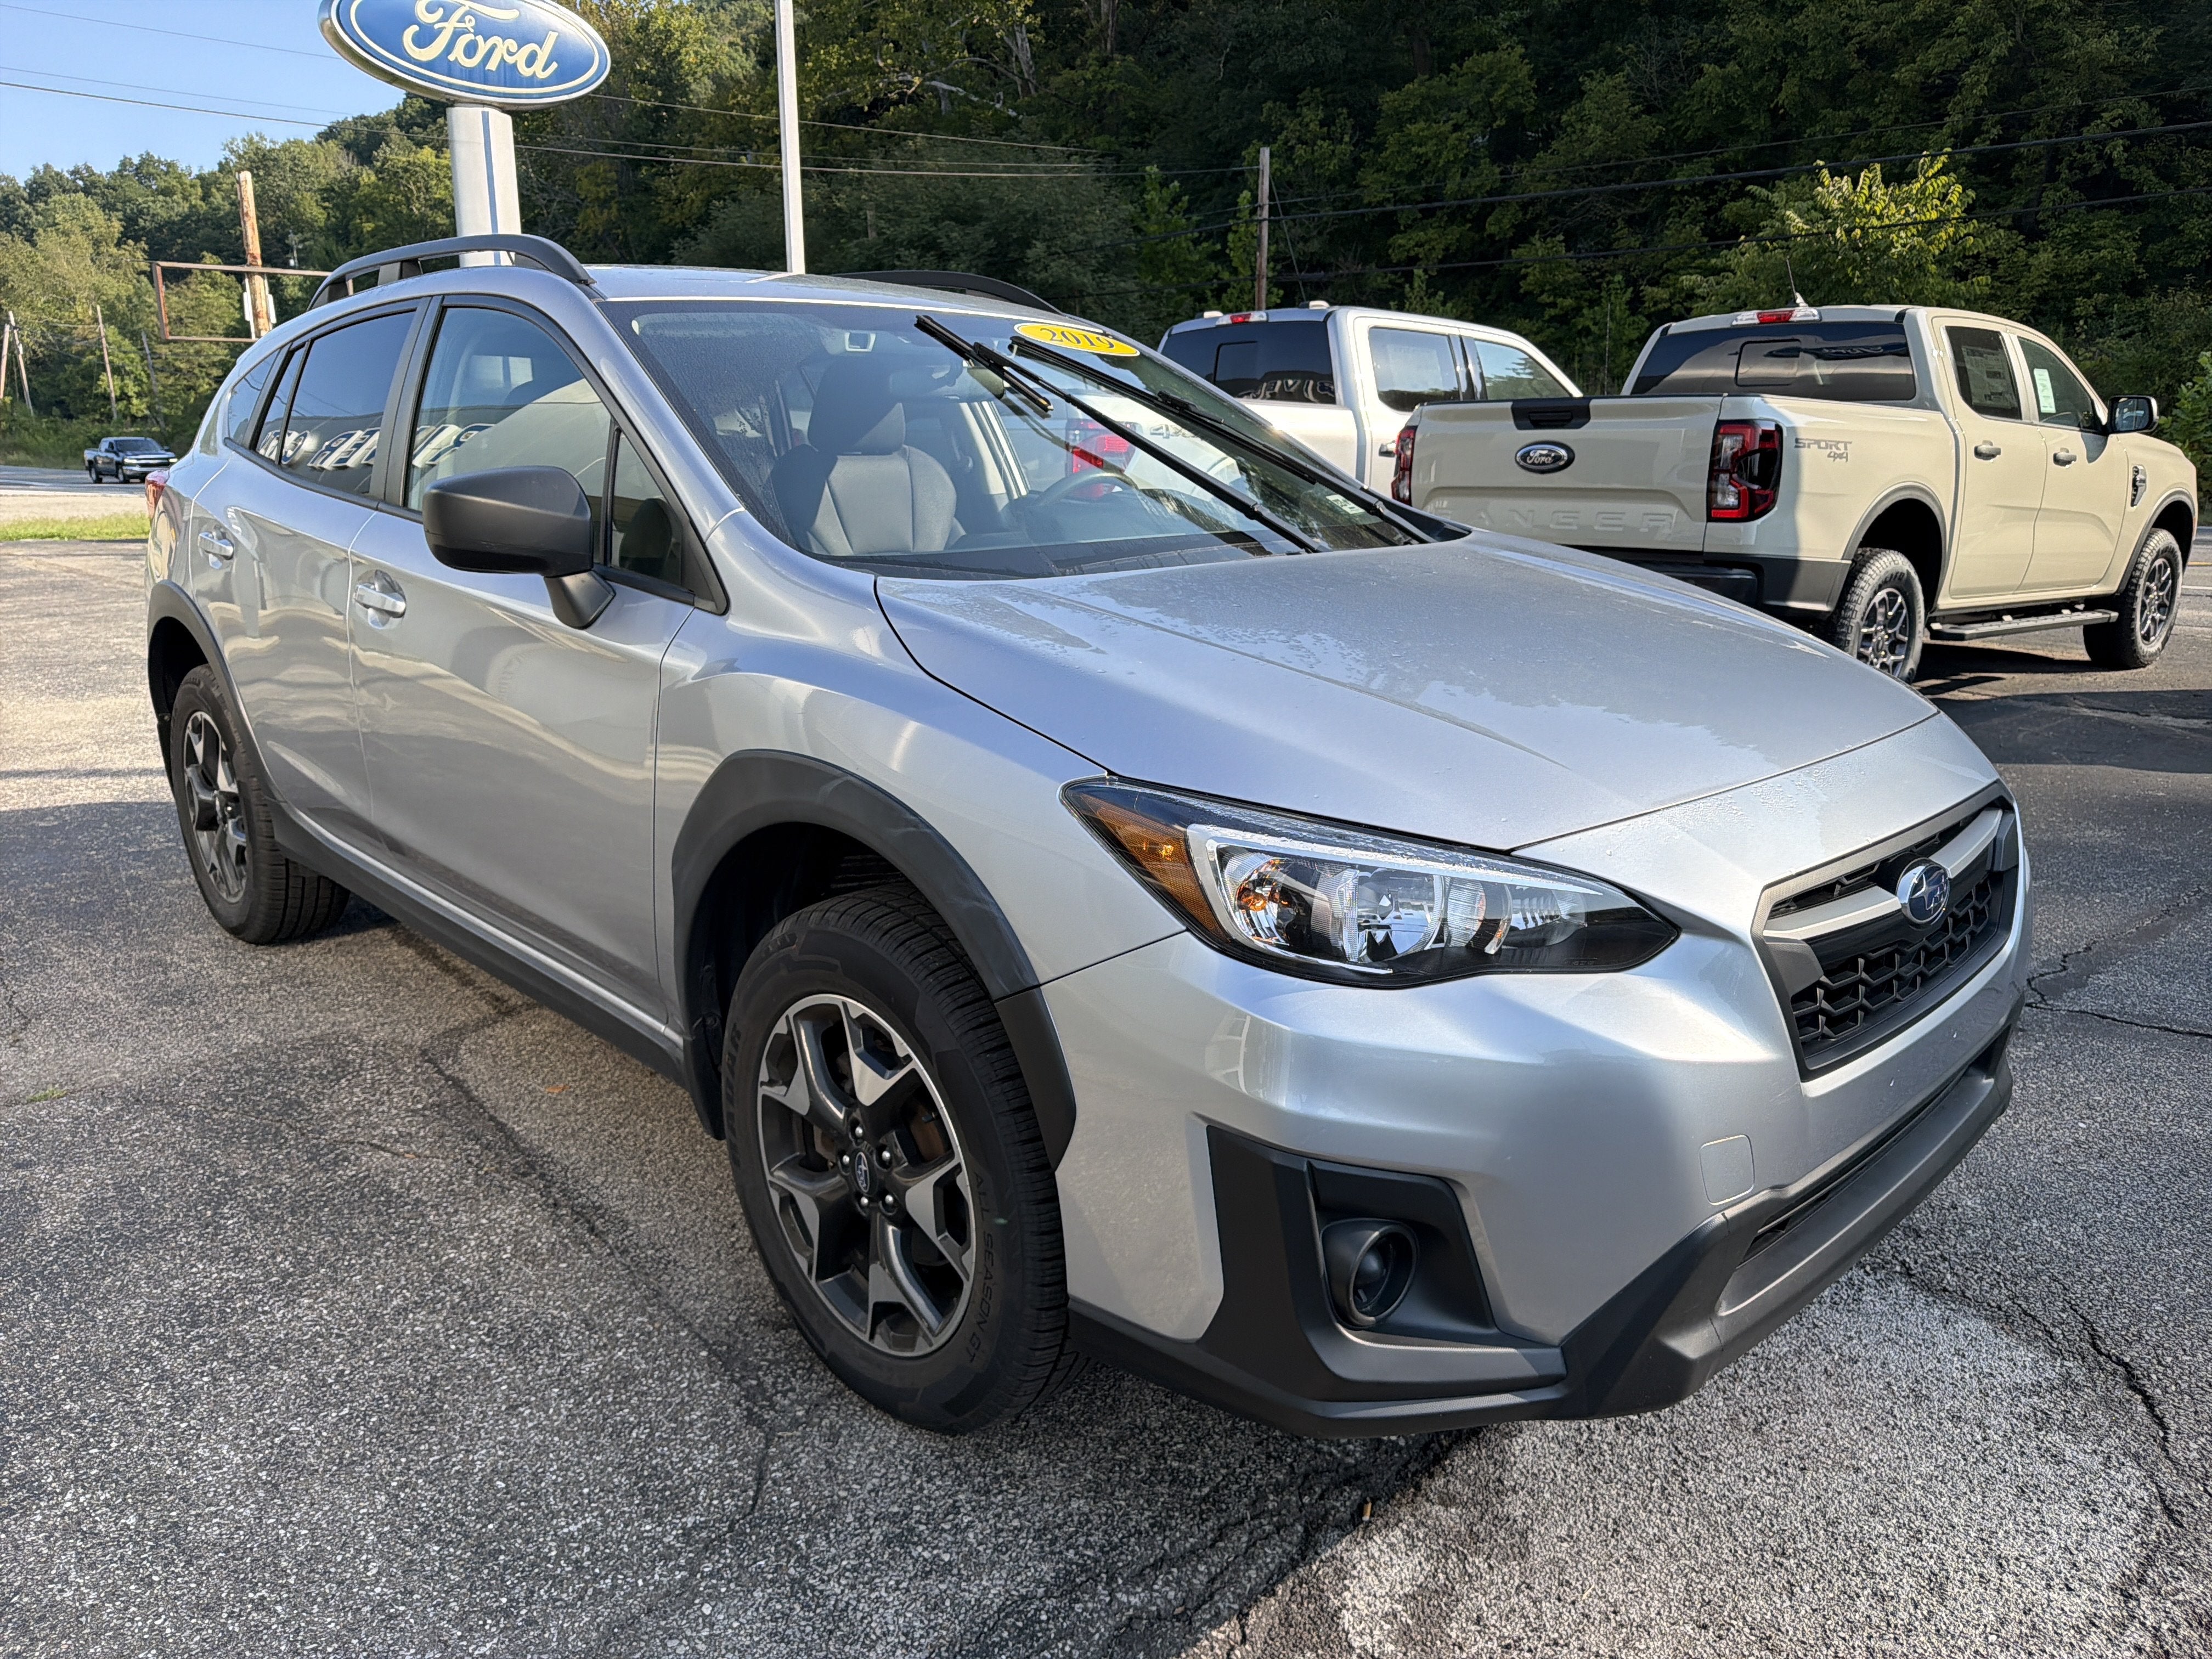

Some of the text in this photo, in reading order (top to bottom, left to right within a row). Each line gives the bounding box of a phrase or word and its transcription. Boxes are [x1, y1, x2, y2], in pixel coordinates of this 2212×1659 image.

[403, 0, 558, 79] Ford
[1040, 328, 1115, 348] 2019
[1794, 437, 1853, 451] SPORT
[1526, 449, 1555, 464] Ford
[966, 1171, 994, 1364] ALL SEASON GT
